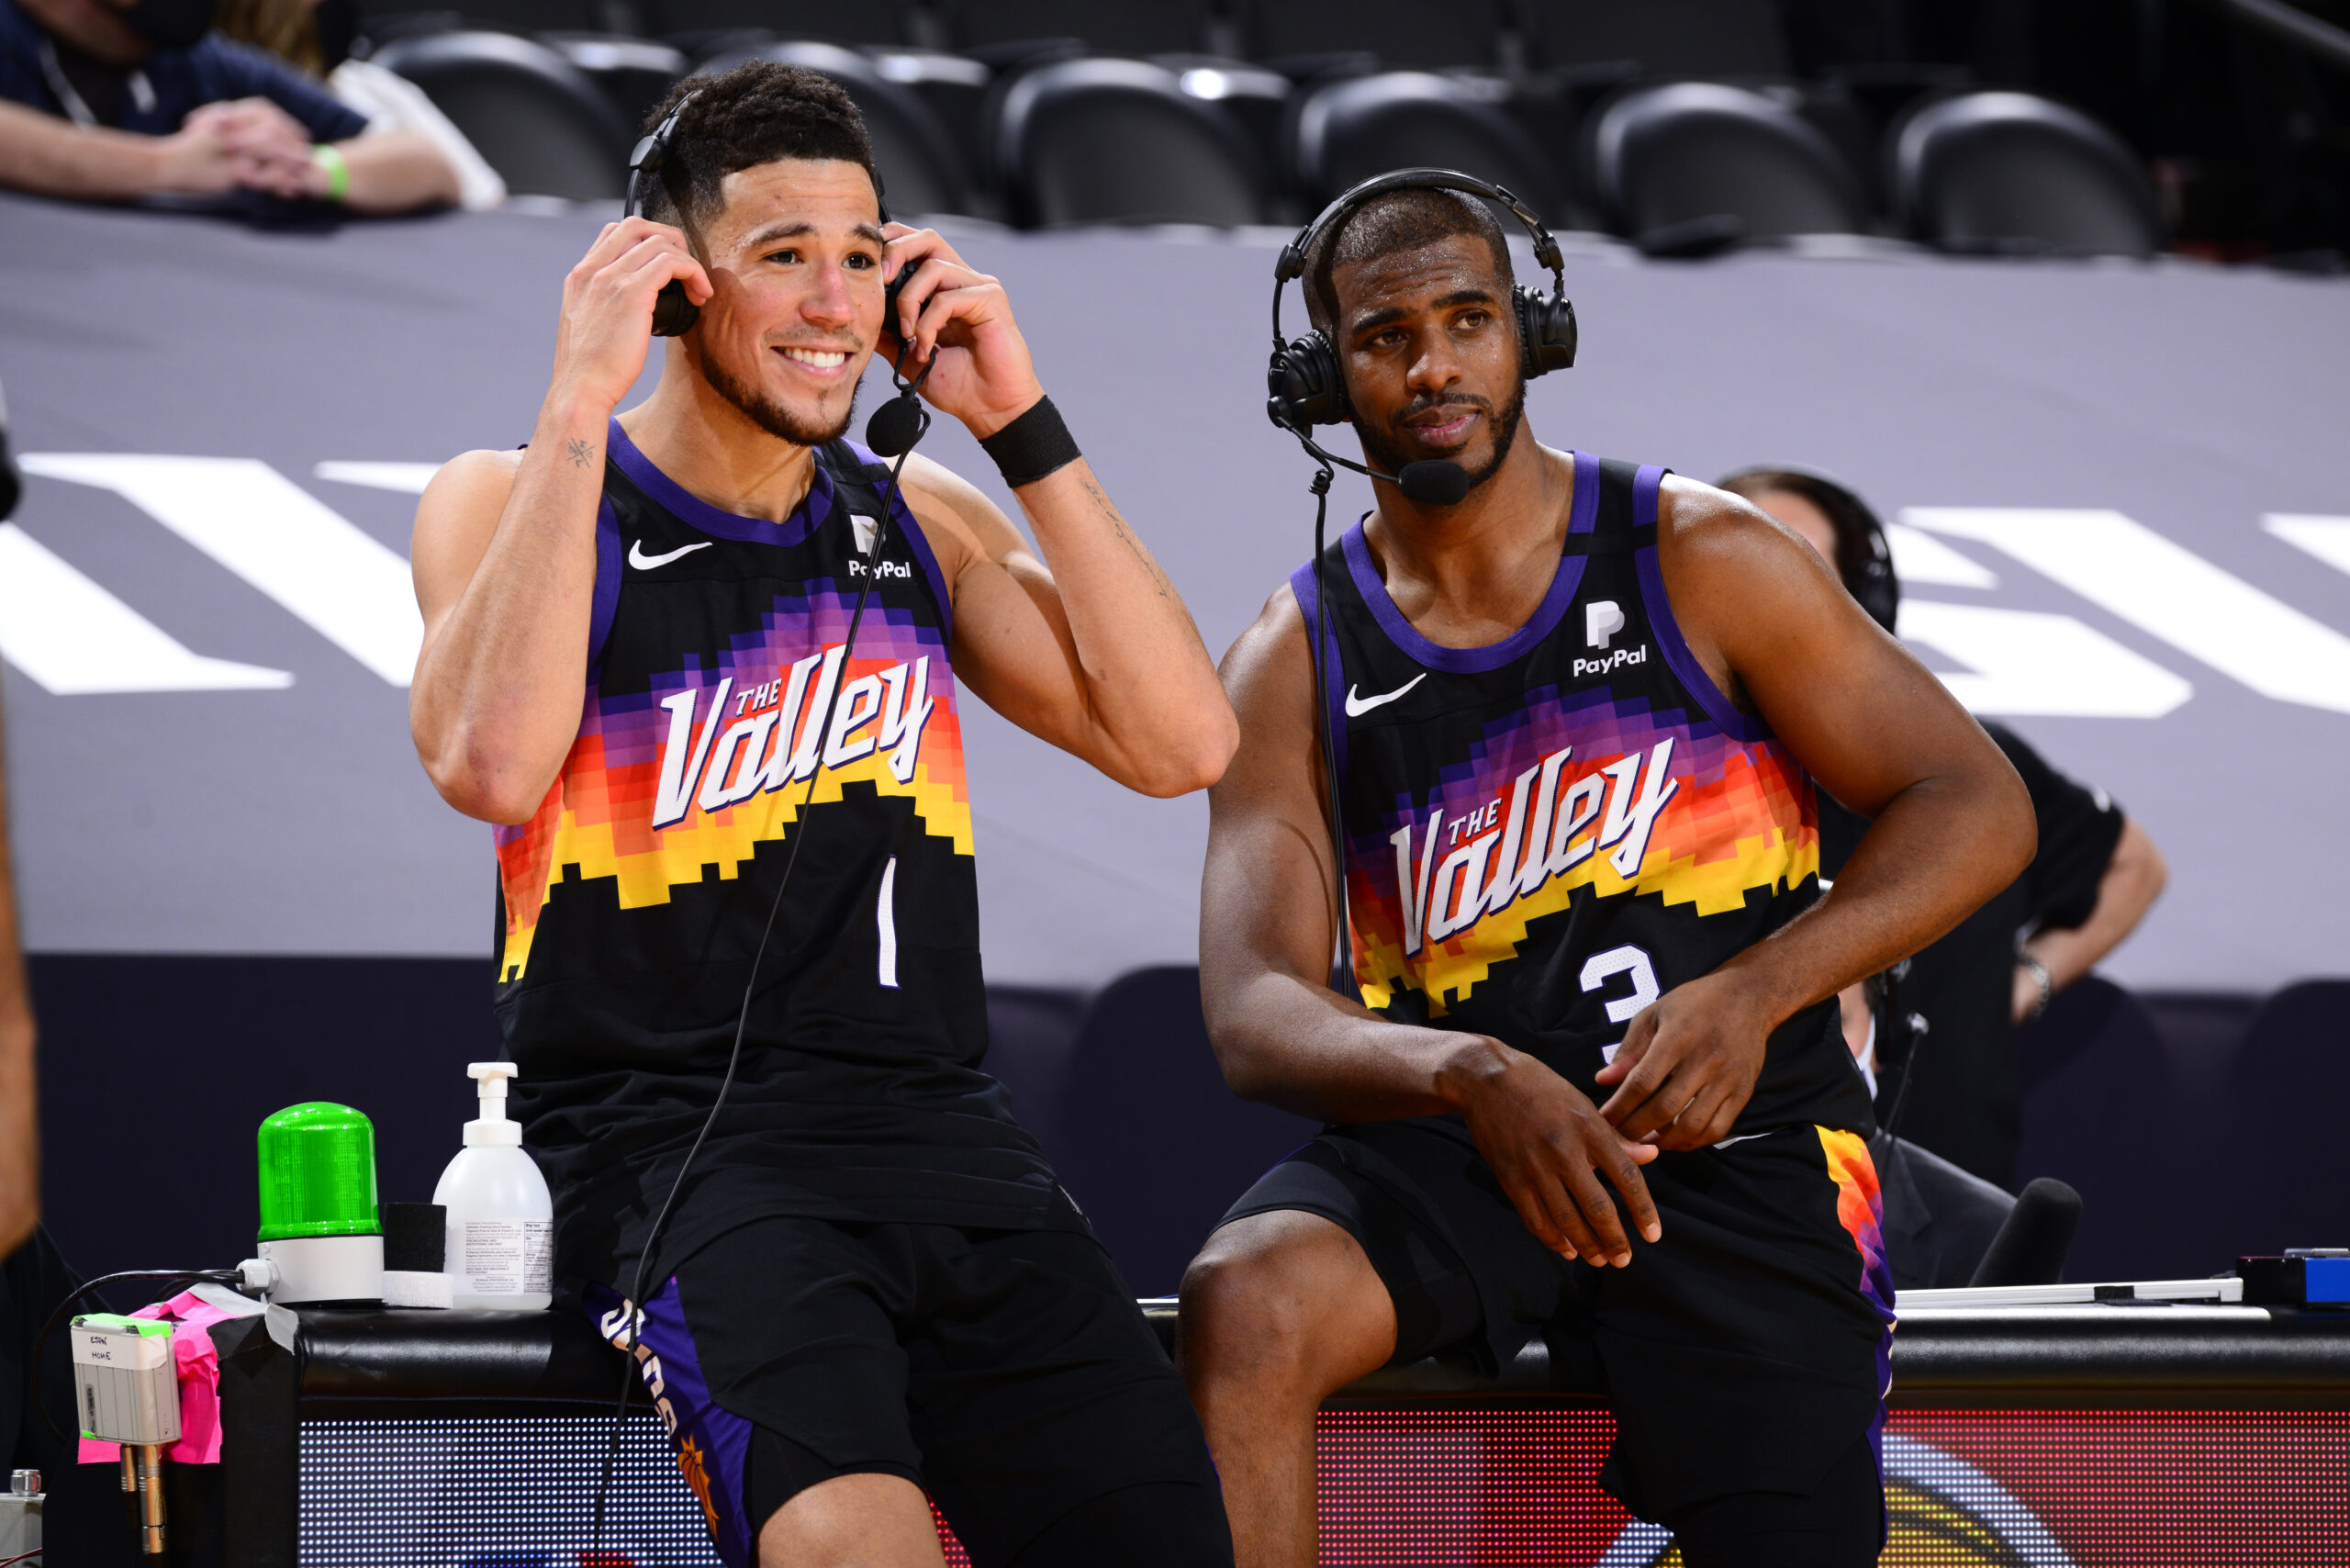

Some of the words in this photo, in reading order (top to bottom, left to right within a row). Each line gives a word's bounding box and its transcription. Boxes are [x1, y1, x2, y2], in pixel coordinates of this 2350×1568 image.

[736, 678, 782, 716] THE
[1573, 644, 1647, 677] PayPal
[653, 644, 934, 832] Valley
[1390, 736, 1680, 959] Valley
[1449, 797, 1503, 846] THE
[877, 854, 901, 990] 1
[1578, 943, 1662, 1066] 3
